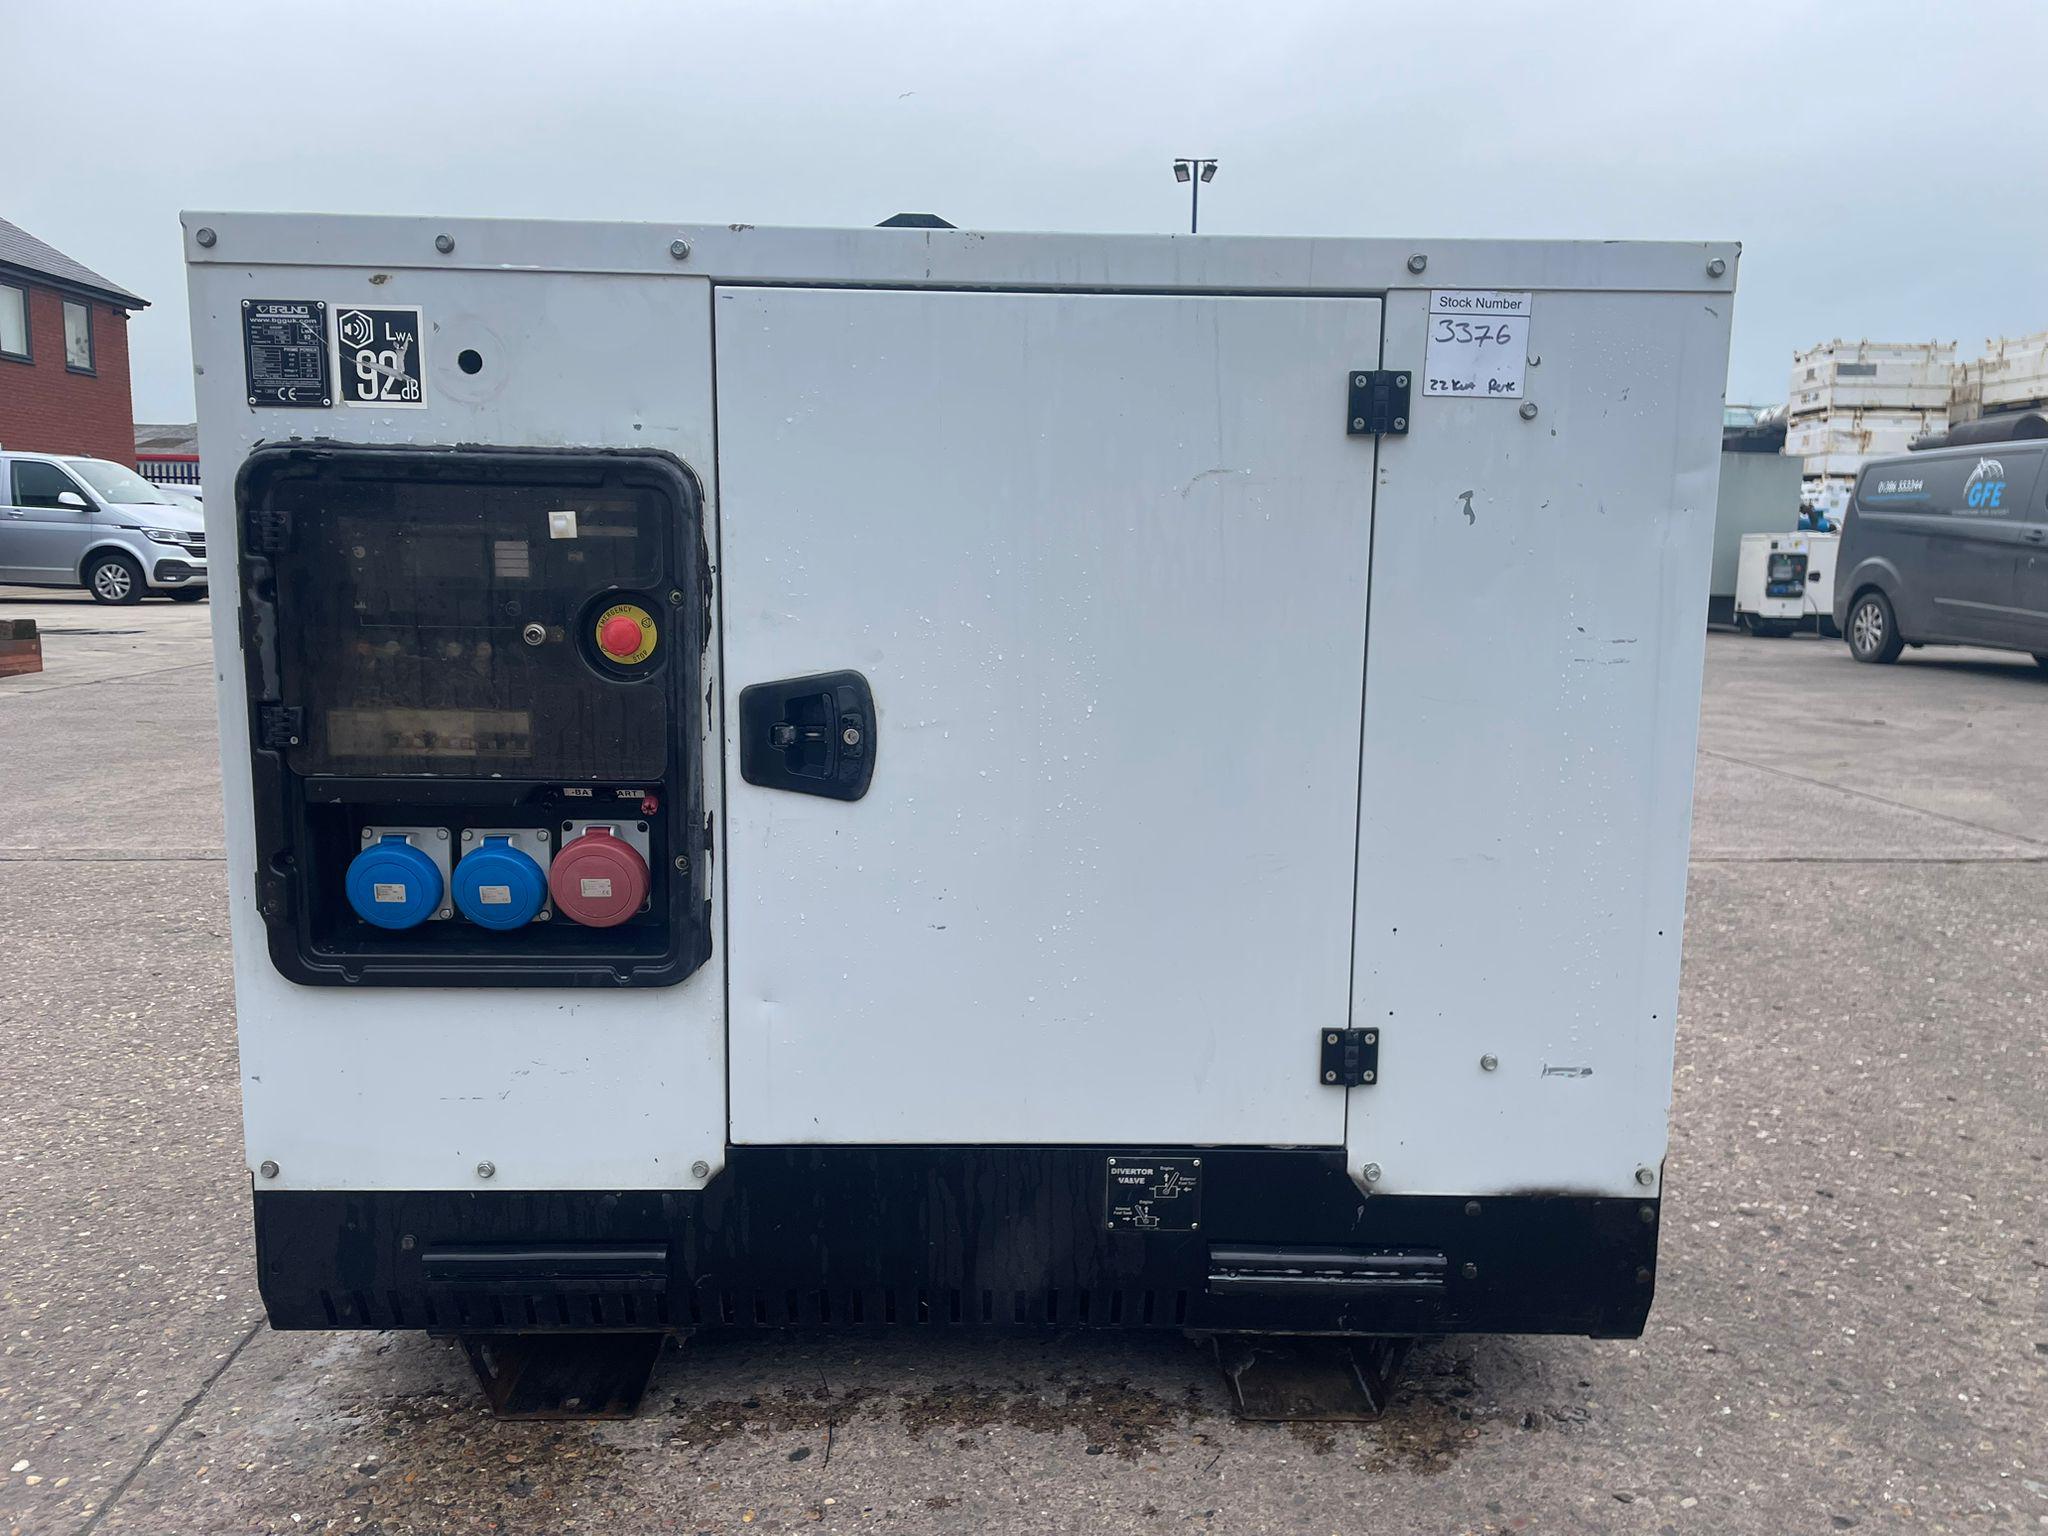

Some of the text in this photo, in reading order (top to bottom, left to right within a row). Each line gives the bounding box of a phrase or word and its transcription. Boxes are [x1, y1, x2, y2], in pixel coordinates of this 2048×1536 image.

[1439, 296, 1522, 310] Stock Number
[1435, 319, 1511, 347] 3376
[356, 349, 420, 400] 92 dB
[1968, 481, 2007, 508] GFE
[598, 605, 632, 629] EMERGENCY
[632, 649, 648, 663] STOP
